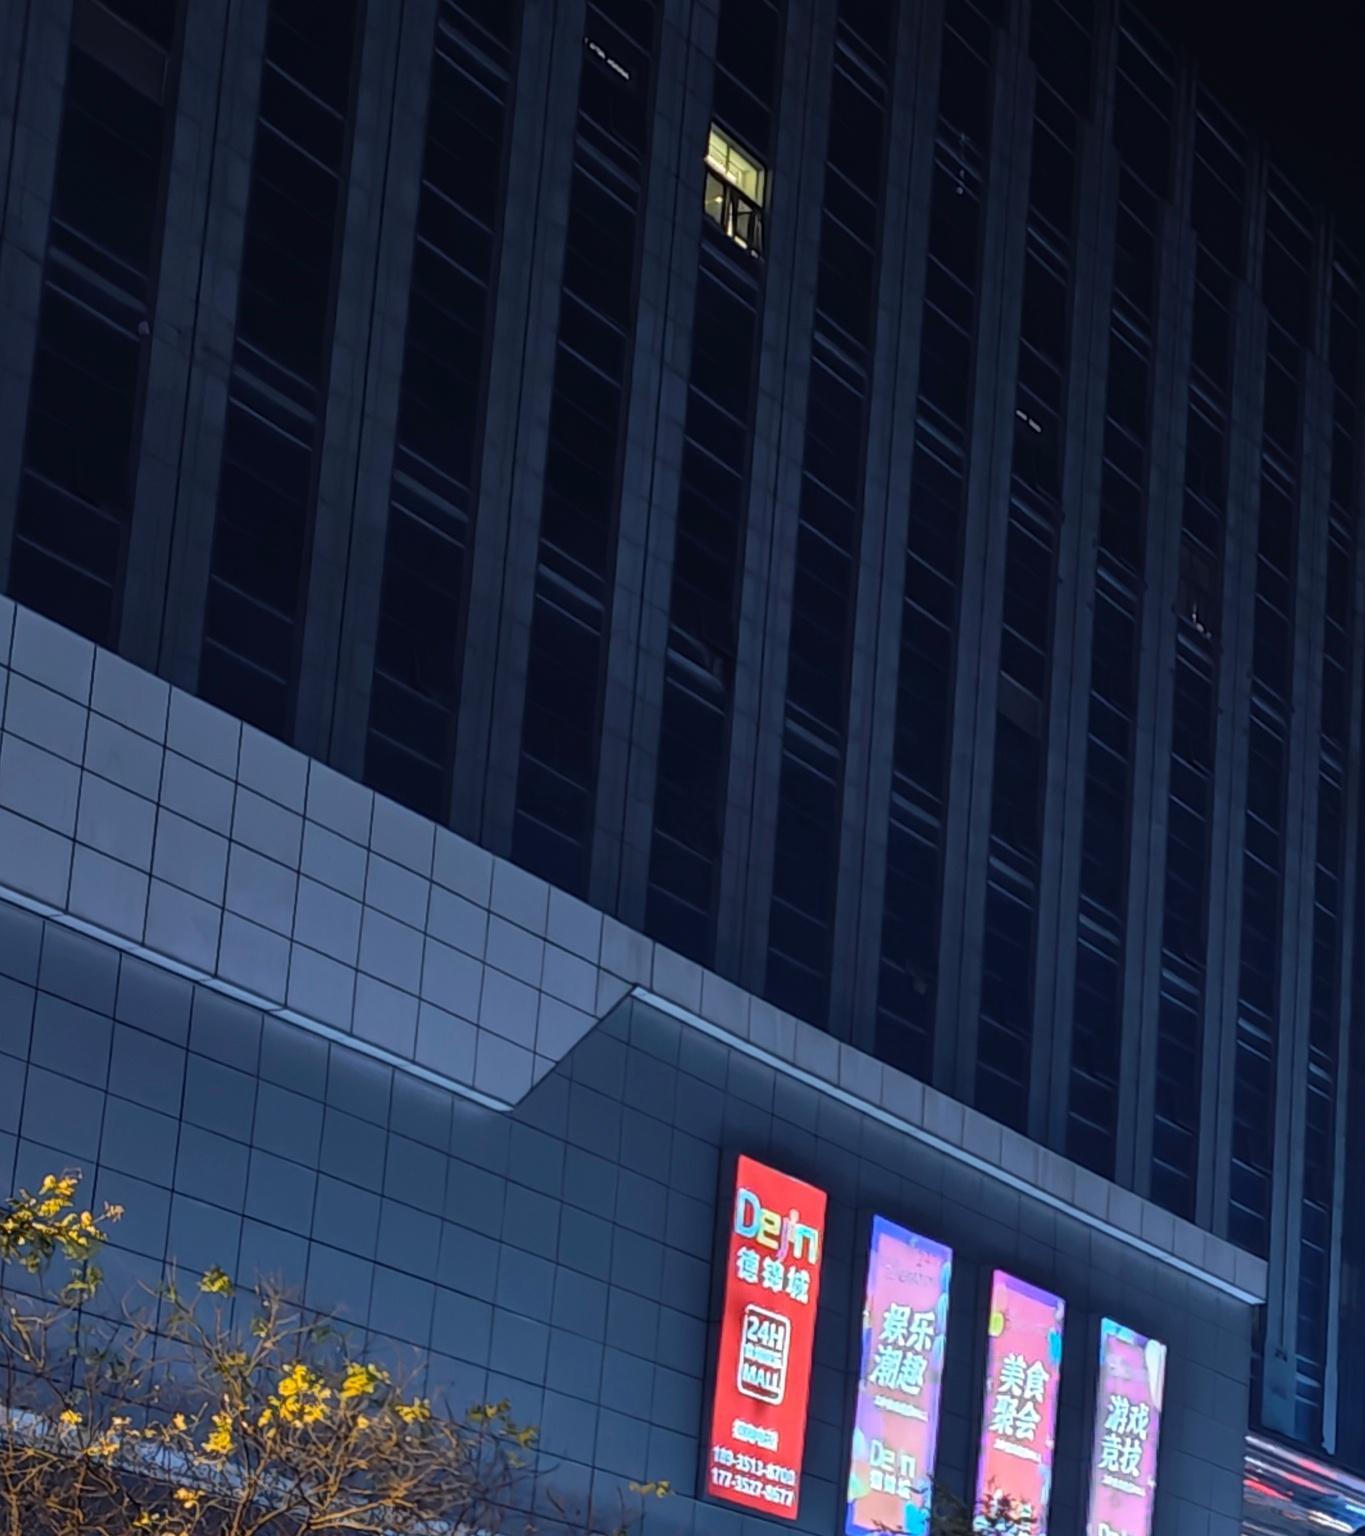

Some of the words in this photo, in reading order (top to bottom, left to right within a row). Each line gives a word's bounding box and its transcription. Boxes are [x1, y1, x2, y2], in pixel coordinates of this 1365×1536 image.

[746, 1315, 785, 1350] 24H
[742, 1363, 781, 1390] MALL
[997, 1352, 1050, 1403] 美食
[989, 1393, 1041, 1442] 聚会
